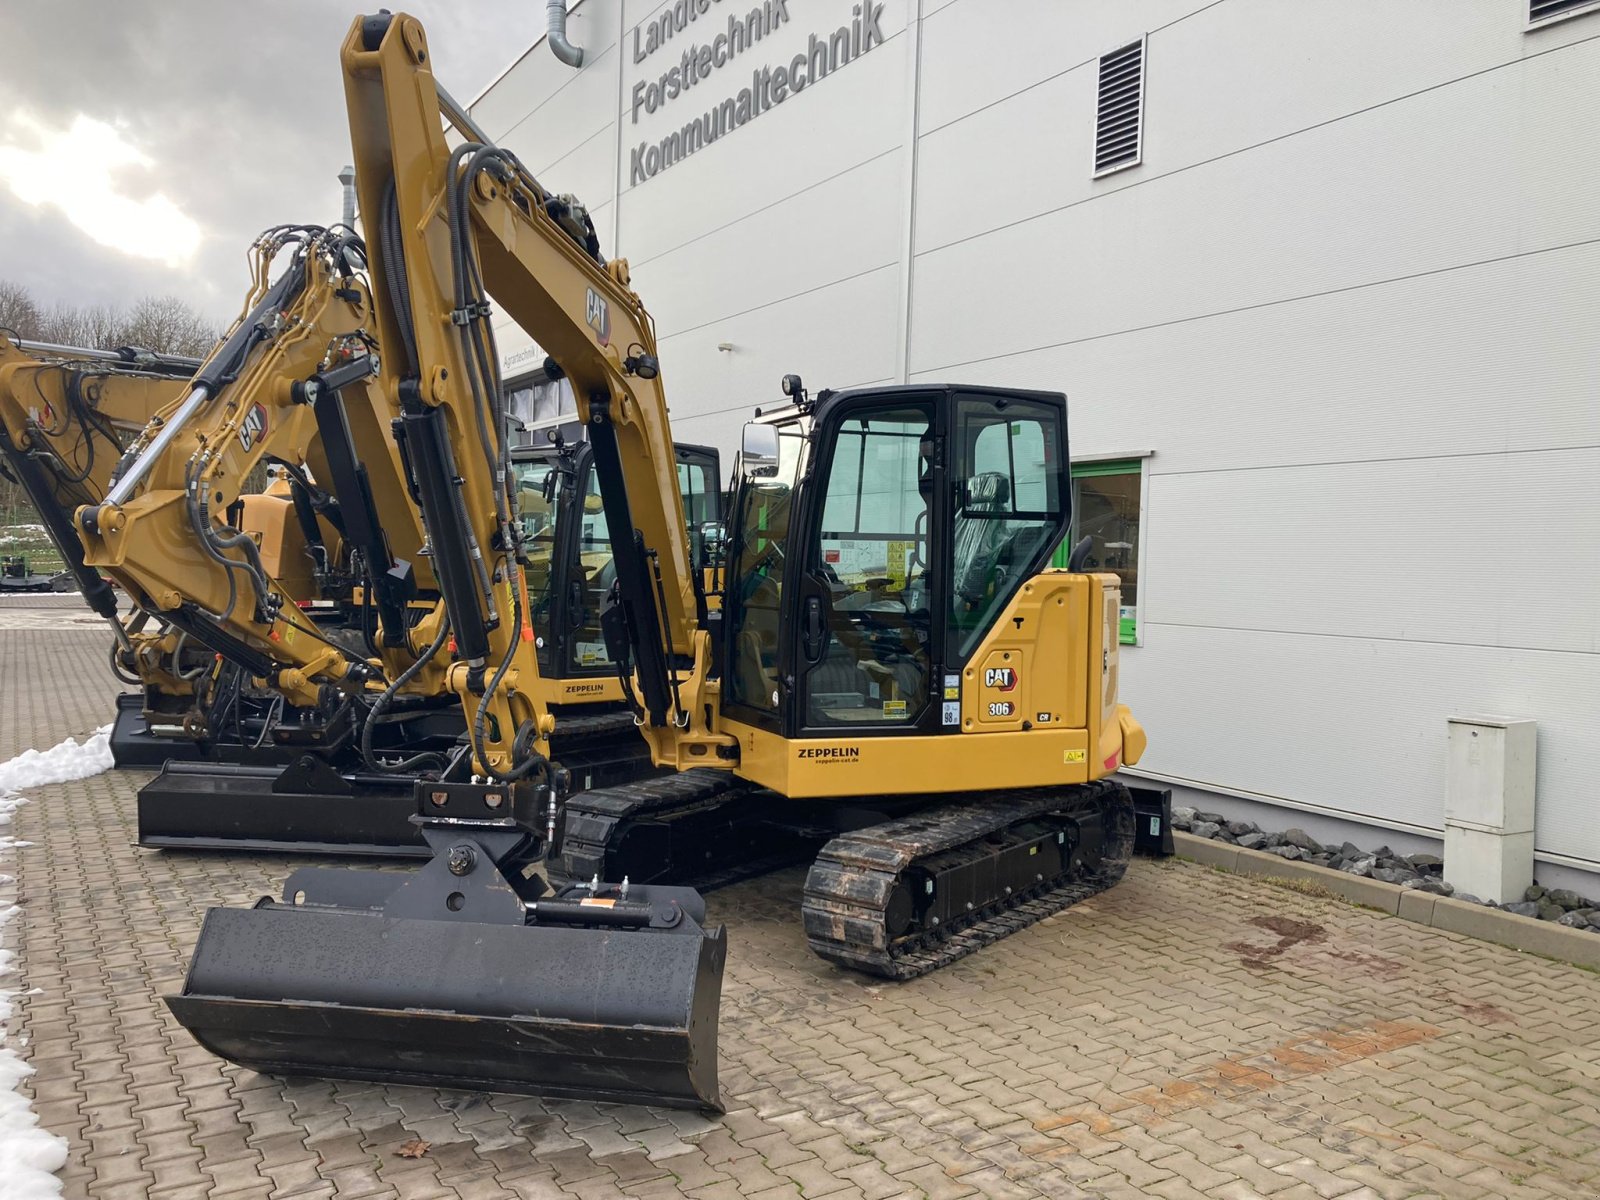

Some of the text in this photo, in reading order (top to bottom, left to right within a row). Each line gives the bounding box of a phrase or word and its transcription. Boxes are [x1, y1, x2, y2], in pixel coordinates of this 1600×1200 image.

[631, 0, 790, 124] Forsttechnik
[630, 0, 884, 187] Kommunaltechnik
[586, 287, 607, 335] CAT
[239, 405, 263, 452] CAT
[985, 668, 1010, 687] CAT
[565, 684, 604, 693] ZEPPELIN
[989, 702, 1010, 716] 306
[1039, 713, 1049, 721] CR
[944, 711, 953, 724] 98
[798, 747, 859, 759] ZEPPELIN
